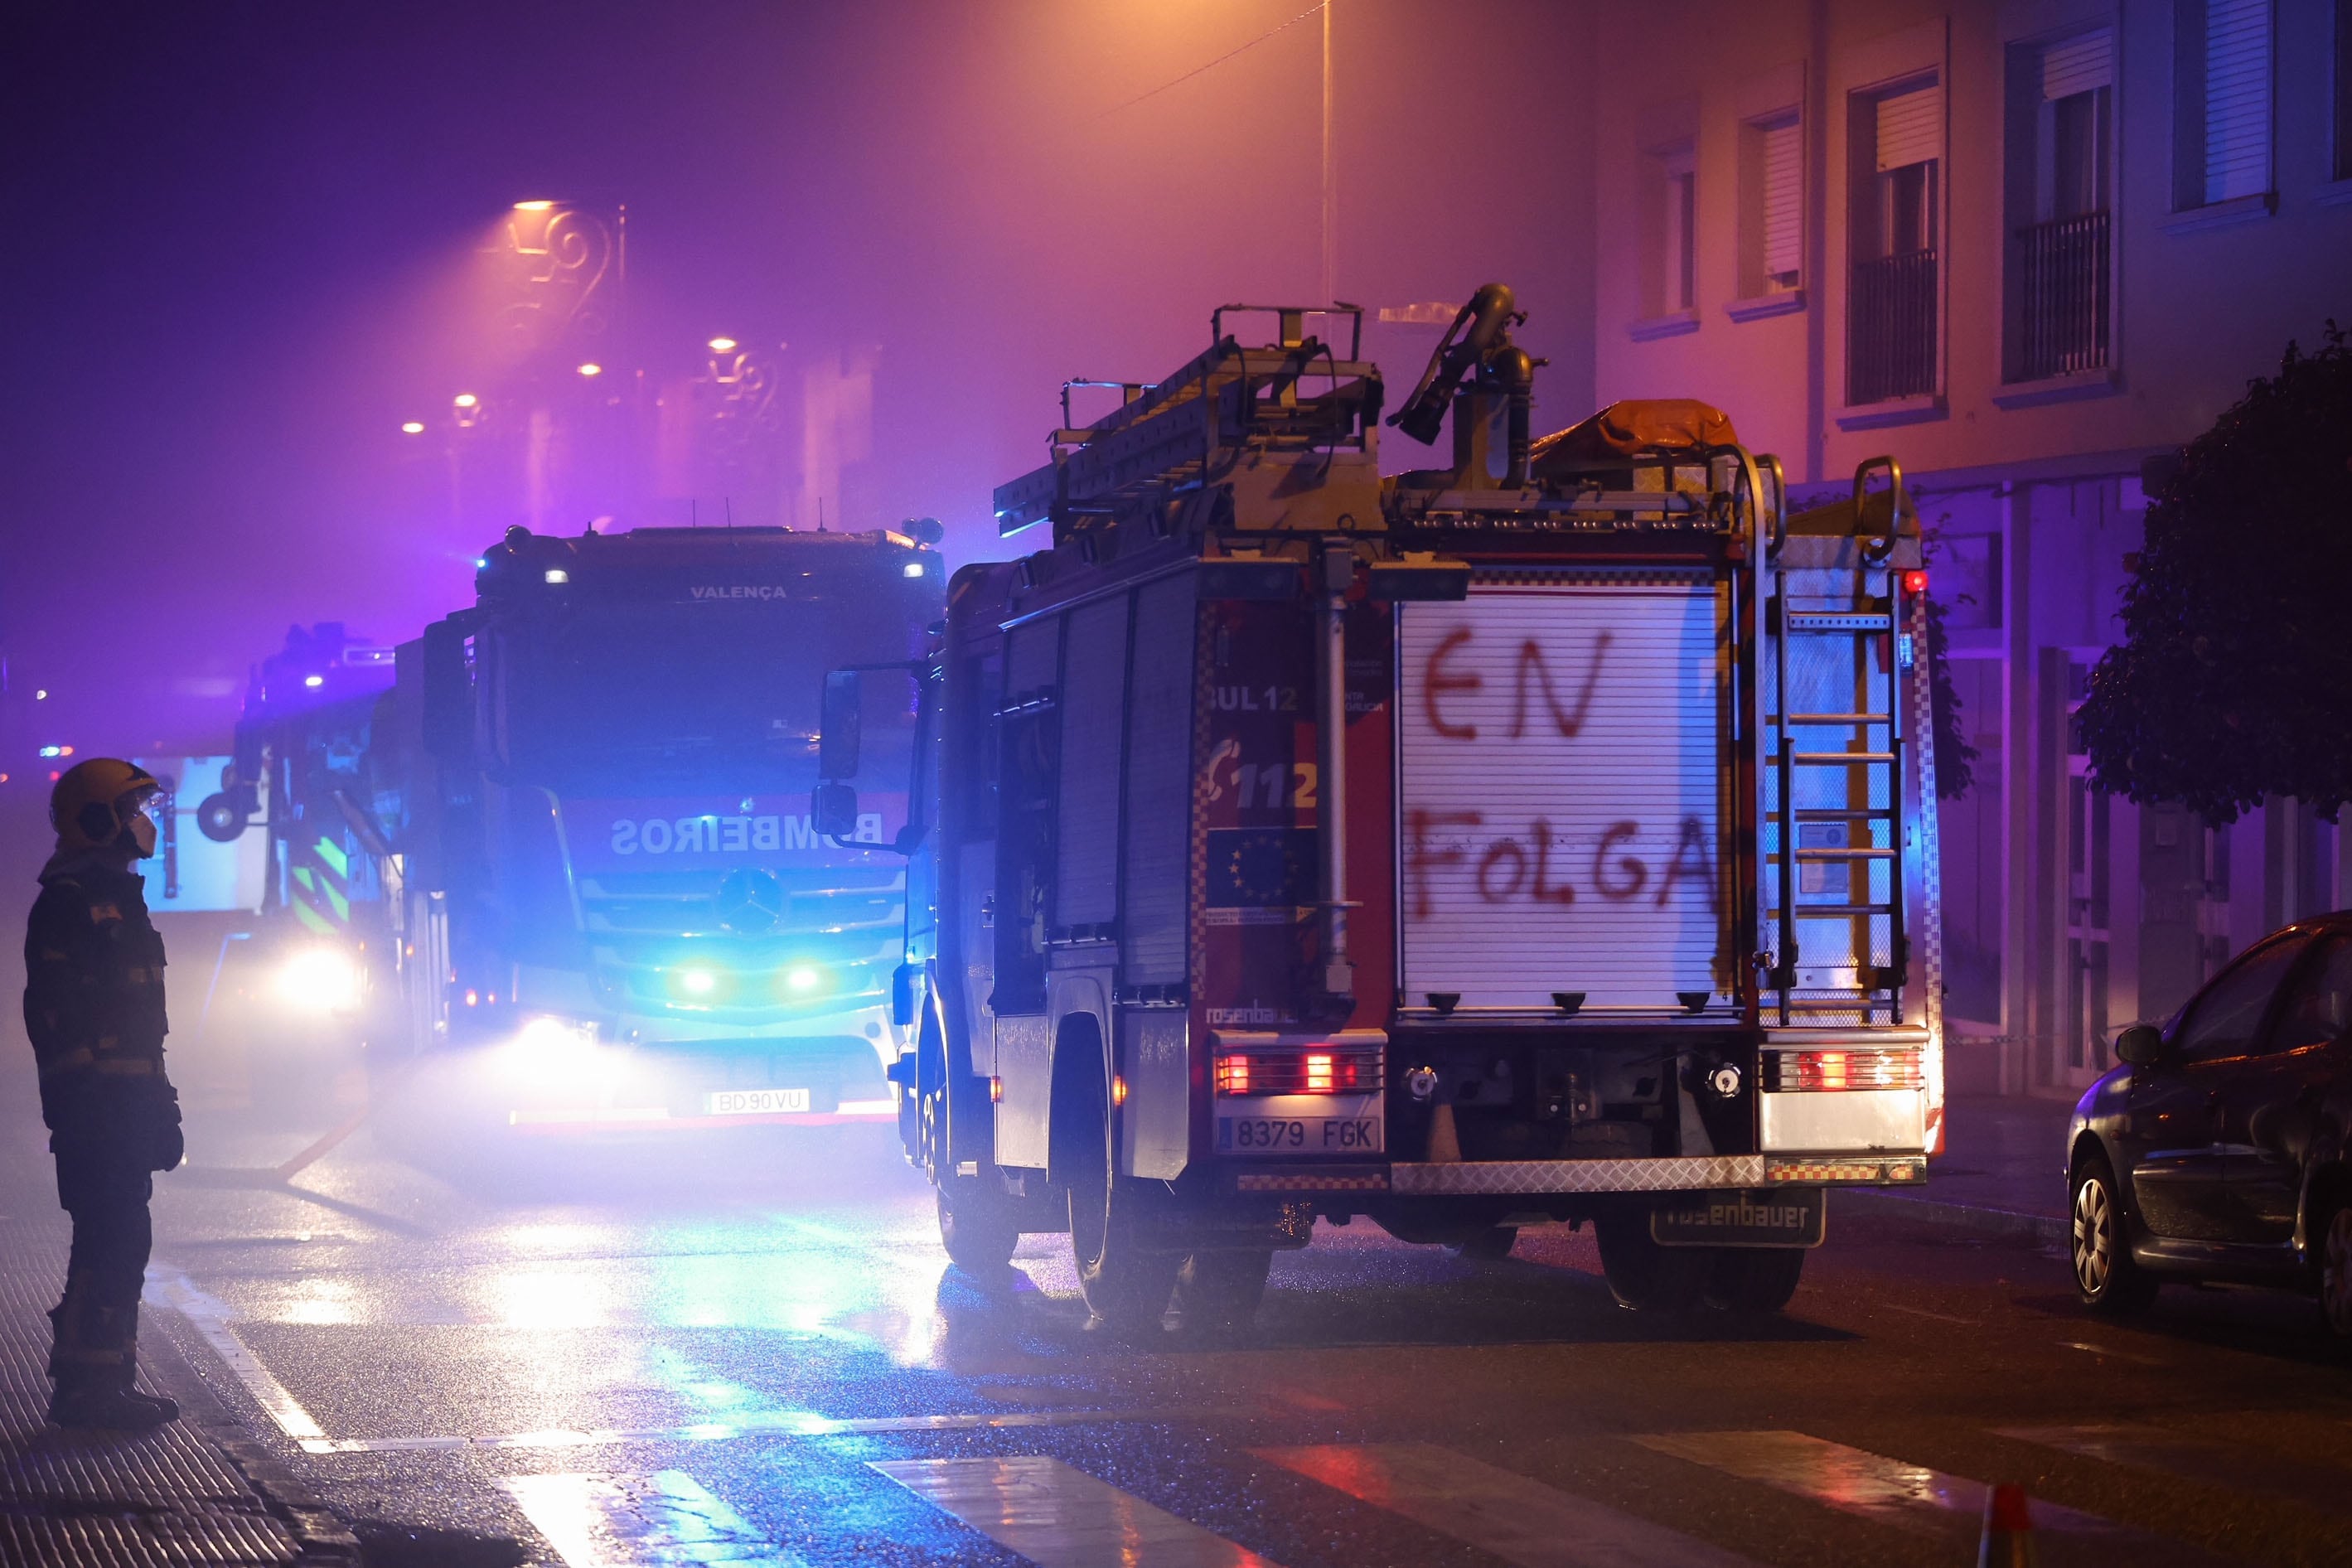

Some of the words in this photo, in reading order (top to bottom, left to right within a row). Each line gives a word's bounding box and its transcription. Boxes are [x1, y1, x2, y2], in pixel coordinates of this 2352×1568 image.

[690, 586, 787, 602] VALENÇA
[1423, 623, 1614, 741] EN
[1264, 685, 1299, 711] 12
[1231, 762, 1318, 809] 112
[719, 1094, 746, 1111] BD
[750, 1092, 771, 1110] 90
[775, 1091, 801, 1109] VU
[1237, 1120, 1304, 1148] 8379
[1323, 1120, 1372, 1149] FGK
